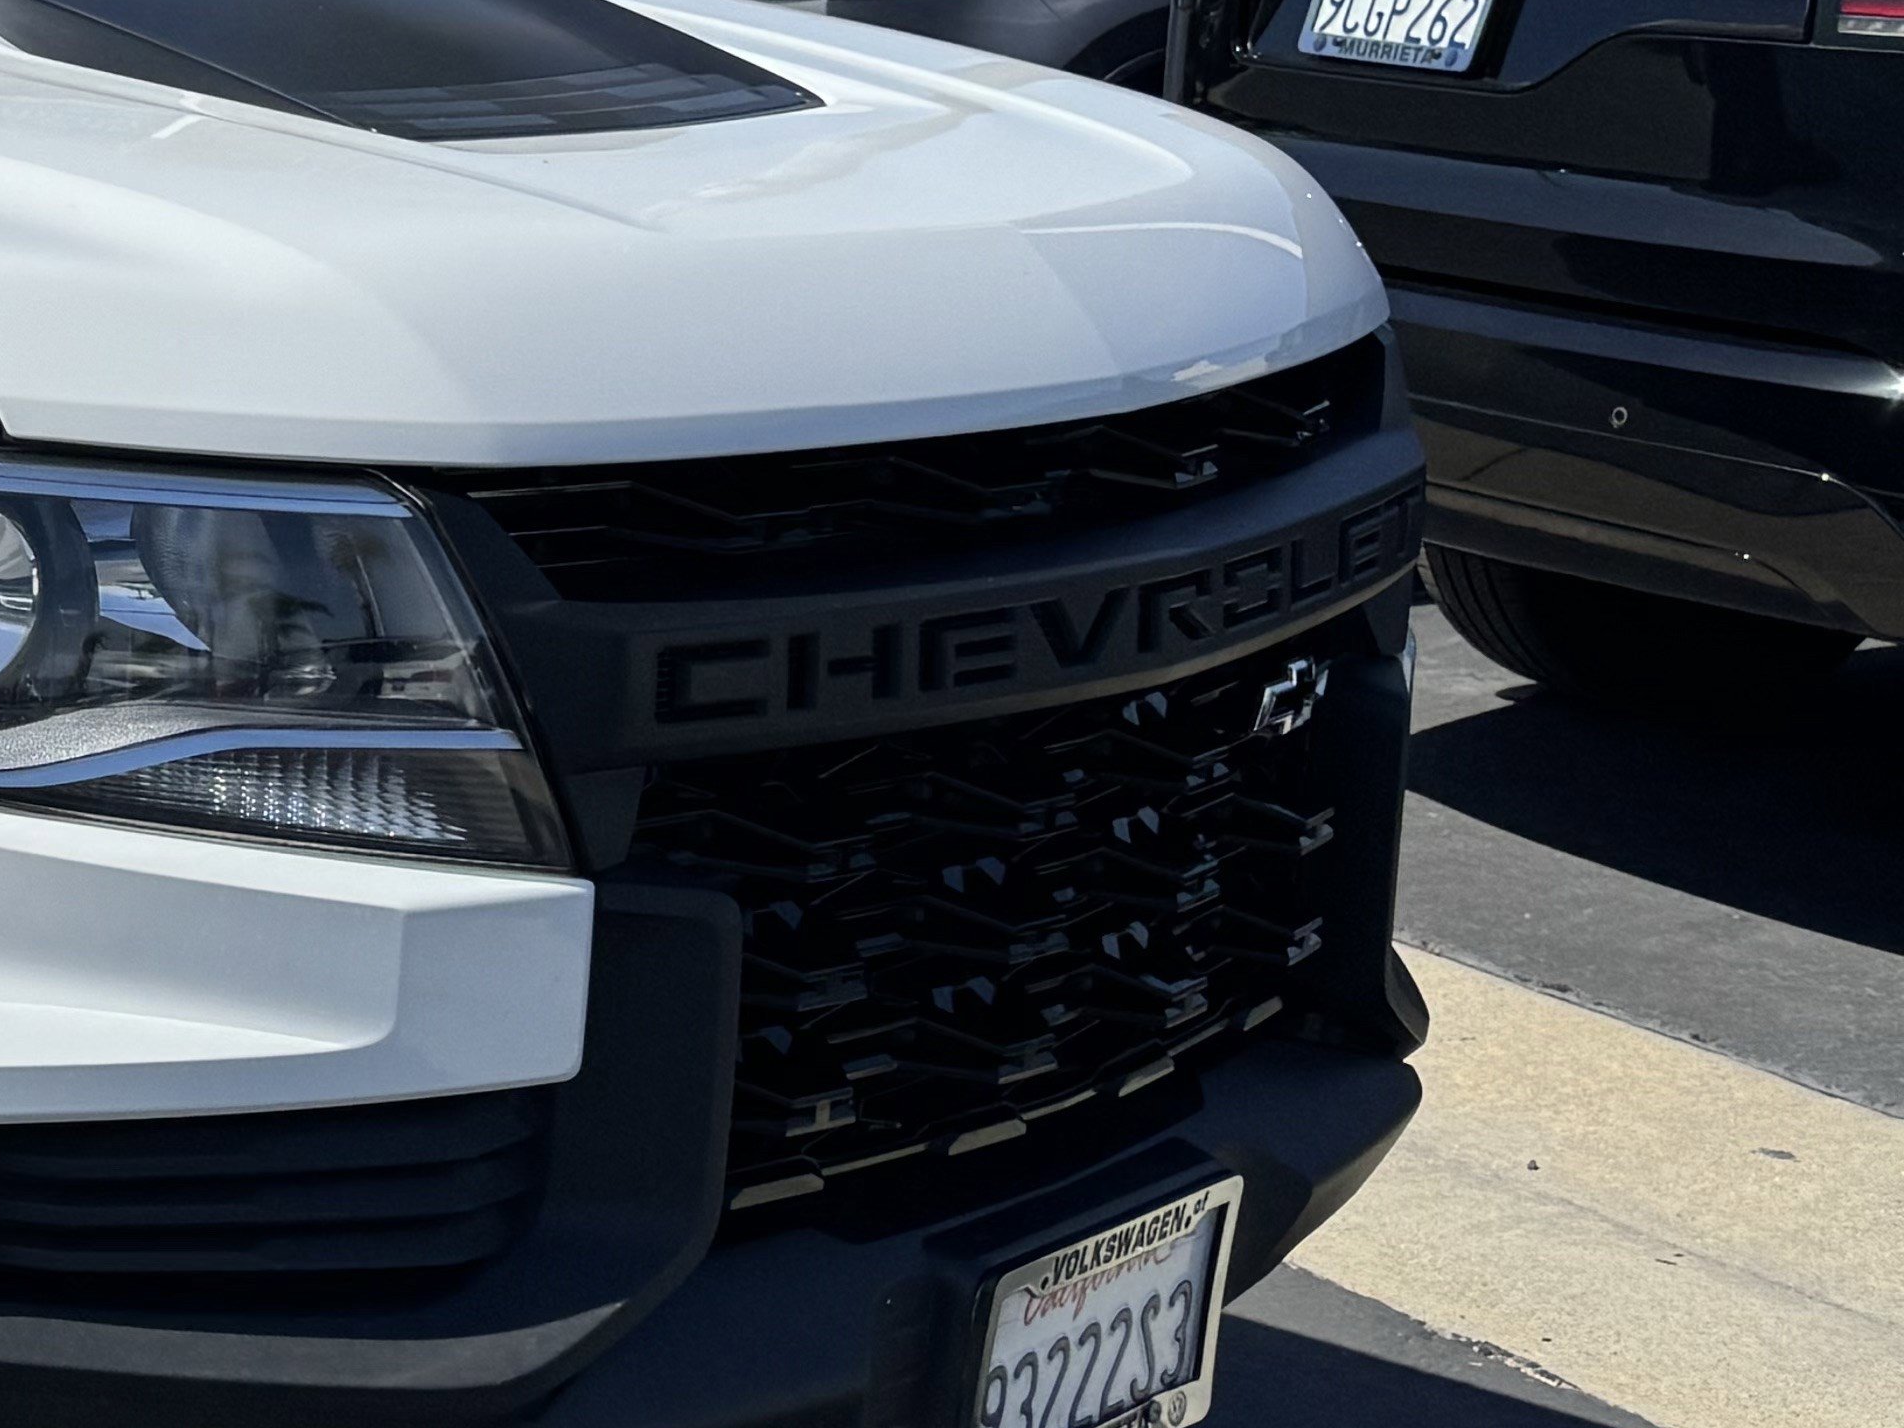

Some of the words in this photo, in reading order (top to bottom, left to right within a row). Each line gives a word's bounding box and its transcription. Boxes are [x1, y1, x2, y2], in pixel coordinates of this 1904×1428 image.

[1338, 38, 1435, 65] MURRIETA
[656, 484, 1424, 726] CHEVROLET
[1051, 1203, 1187, 1287] VOLKSWAGEN
[1194, 1189, 1211, 1215] of
